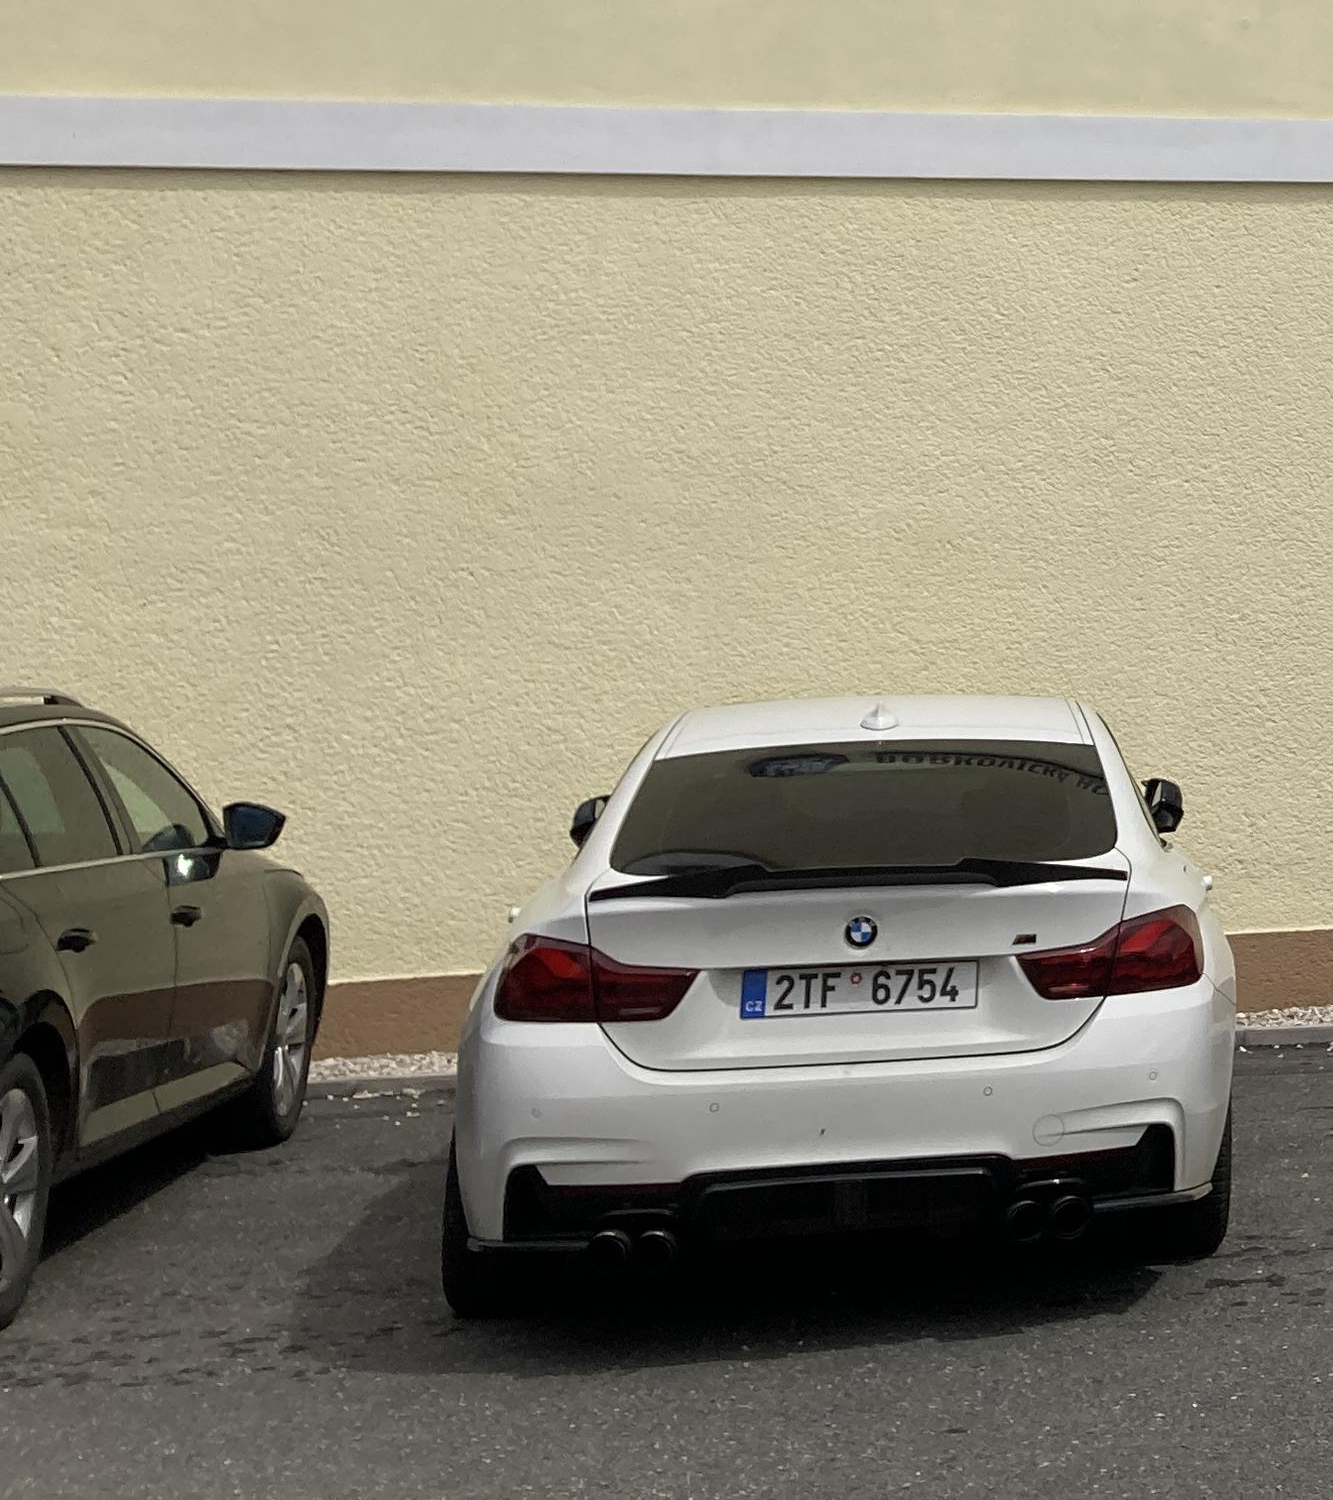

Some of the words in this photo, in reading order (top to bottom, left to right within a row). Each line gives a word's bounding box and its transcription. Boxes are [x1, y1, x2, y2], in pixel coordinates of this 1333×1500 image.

[745, 1000, 763, 1012] CZ
[773, 972, 842, 1011] 2TF
[871, 967, 960, 1006] 6754
